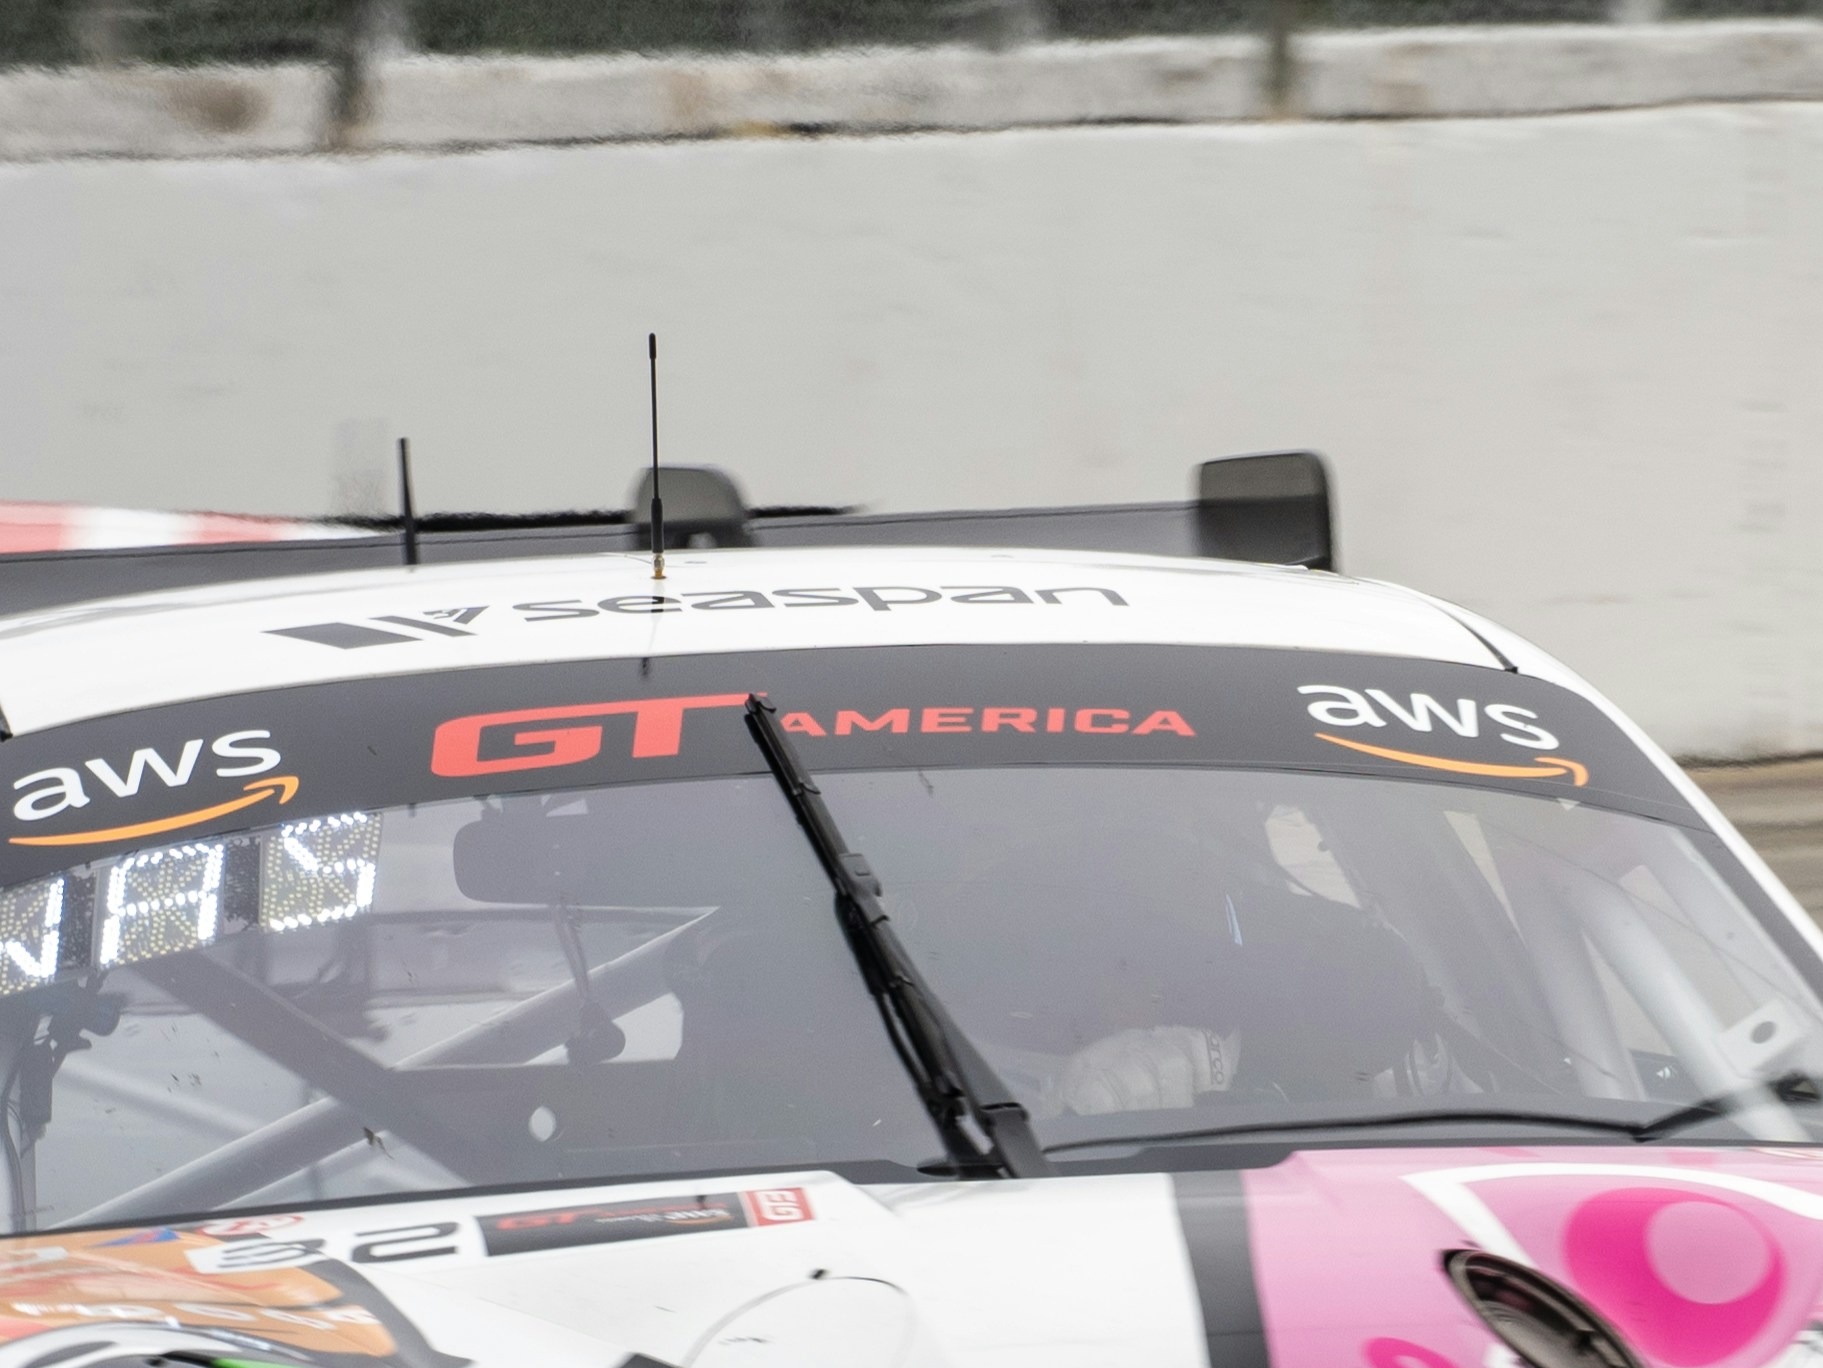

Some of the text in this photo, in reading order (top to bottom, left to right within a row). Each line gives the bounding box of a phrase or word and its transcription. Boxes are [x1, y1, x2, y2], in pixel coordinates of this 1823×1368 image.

[513, 585, 1131, 623] seaspan
[430, 691, 1196, 777] GT AMERICA
[1296, 683, 1560, 751] aws
[12, 729, 282, 822] aws
